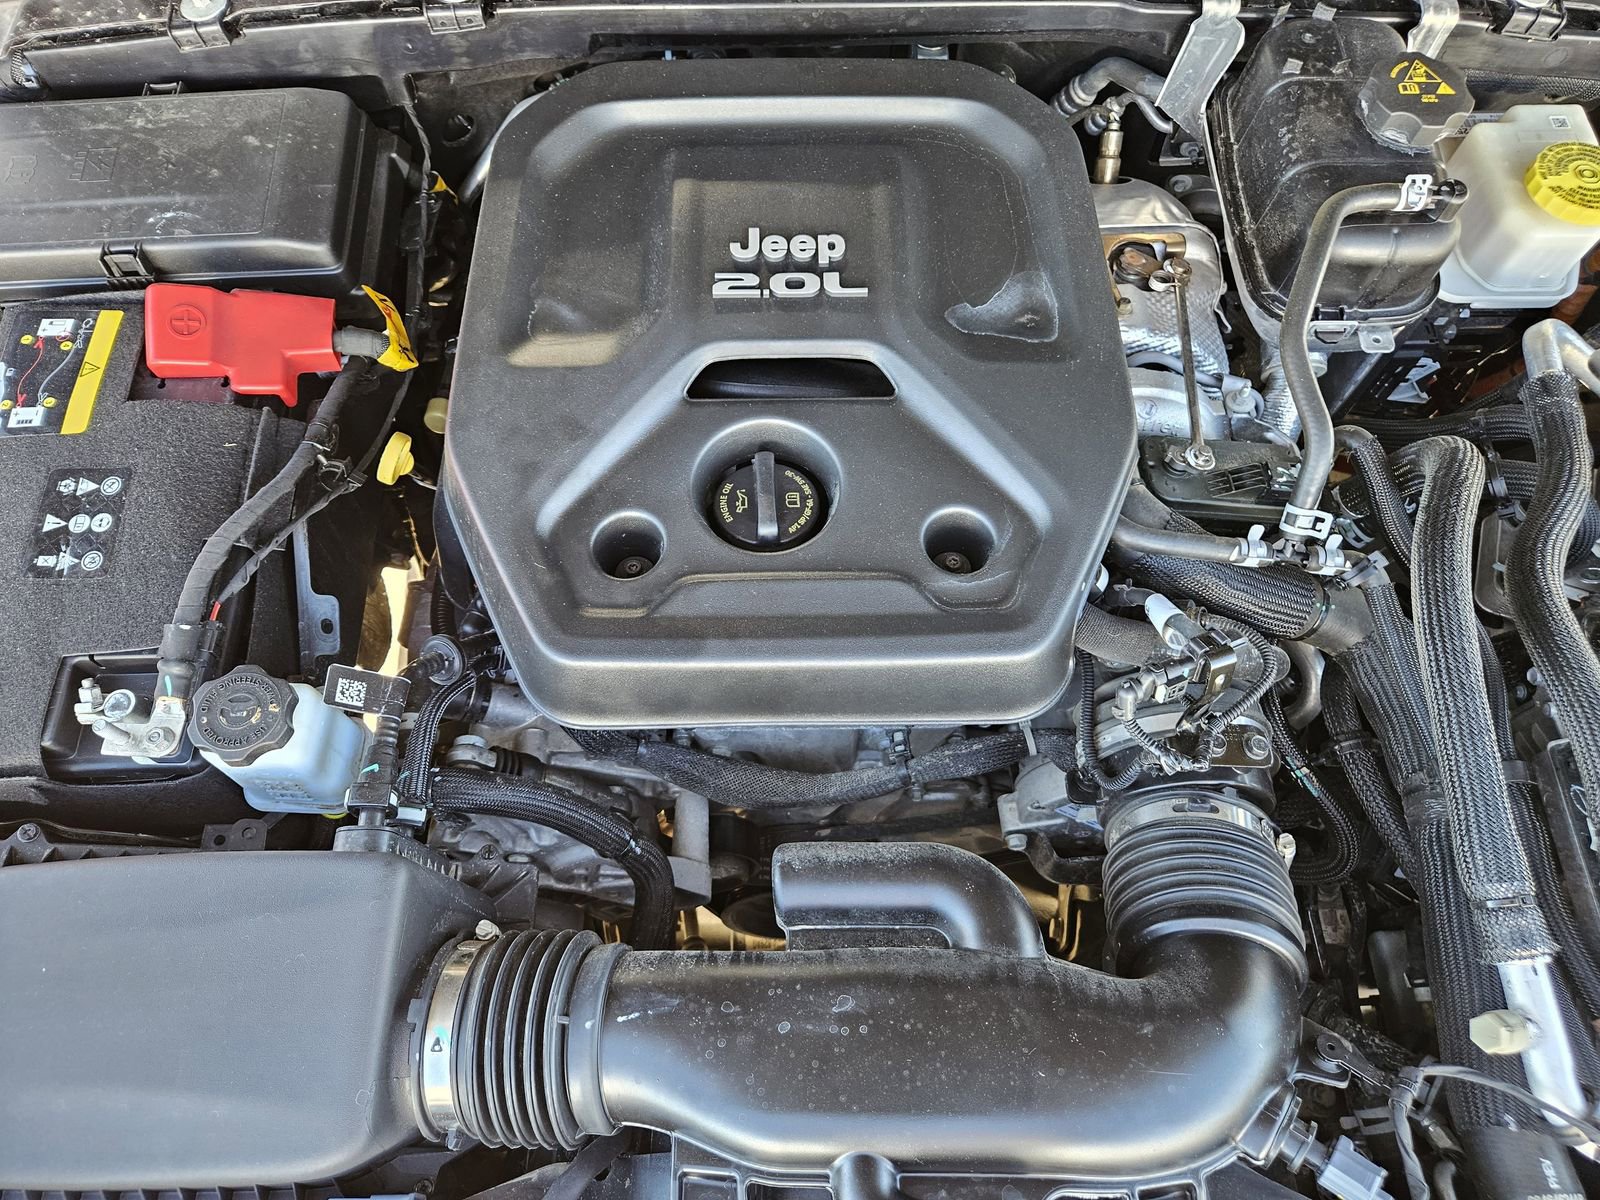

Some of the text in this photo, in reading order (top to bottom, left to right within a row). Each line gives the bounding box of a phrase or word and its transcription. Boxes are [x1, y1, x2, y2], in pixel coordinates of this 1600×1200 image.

[730, 228, 845, 267] Jeep
[712, 272, 868, 298] 2.0L
[719, 482, 734, 523] ENGINE OIL
[788, 522, 800, 533] API
[800, 481, 812, 496] SAE
[218, 676, 261, 690] STEERING
[201, 689, 218, 712] FLUID
[203, 723, 268, 746] USE APPROVED
